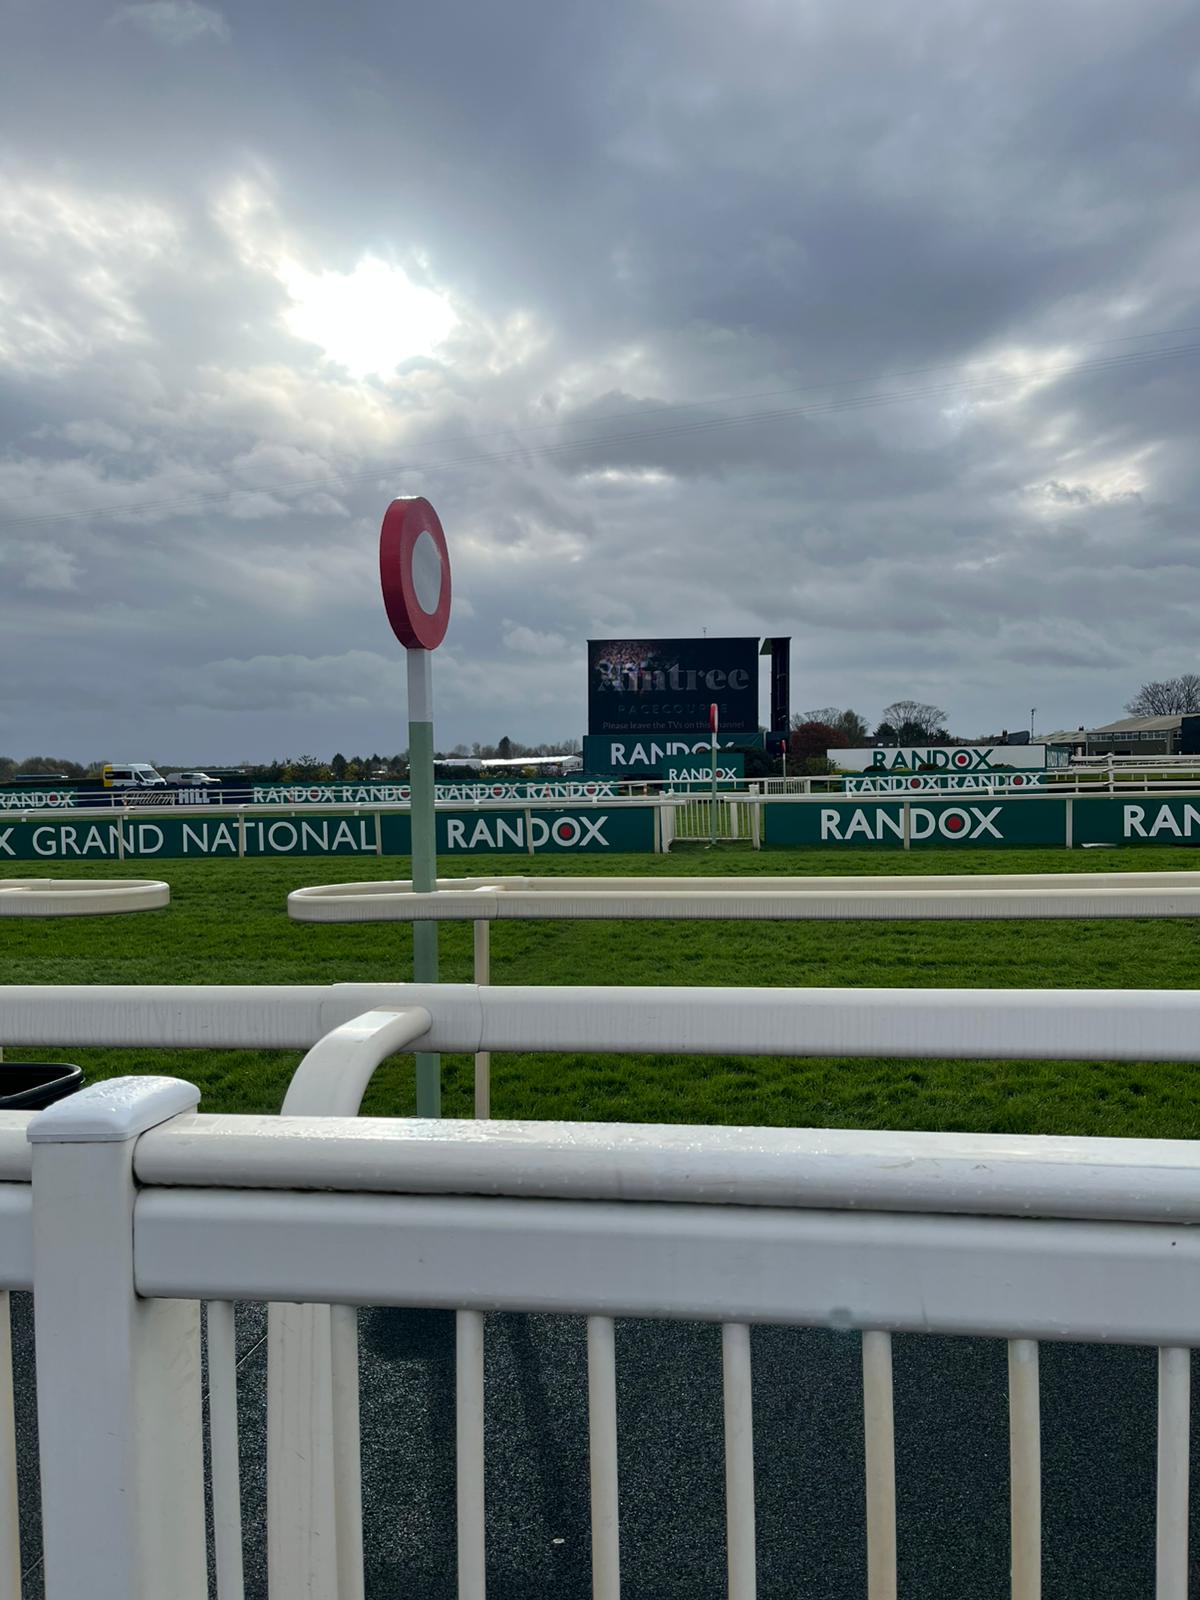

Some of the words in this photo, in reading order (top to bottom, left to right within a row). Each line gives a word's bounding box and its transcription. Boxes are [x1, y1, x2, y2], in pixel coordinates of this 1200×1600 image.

[596, 658, 749, 691] Aintree
[618, 703, 728, 714] RACECOURE
[603, 721, 629, 729] Please
[630, 721, 652, 729] leave
[653, 721, 667, 729] the
[611, 742, 735, 765] RAND
[873, 748, 993, 770] RANDOX
[669, 768, 737, 780] RANDOX
[845, 775, 938, 792] RANDOX
[948, 772, 1041, 789] RANDOX
[178, 788, 210, 804] HILL
[253, 786, 335, 803] RANDOX
[342, 785, 411, 802] RANDO
[434, 783, 520, 800] RANDOX
[526, 781, 615, 798] RANDOX
[447, 816, 610, 849] RANDOX
[820, 807, 1004, 840] RANDOX
[32, 825, 164, 856] GRAND
[182, 820, 377, 853] NATIONAL
